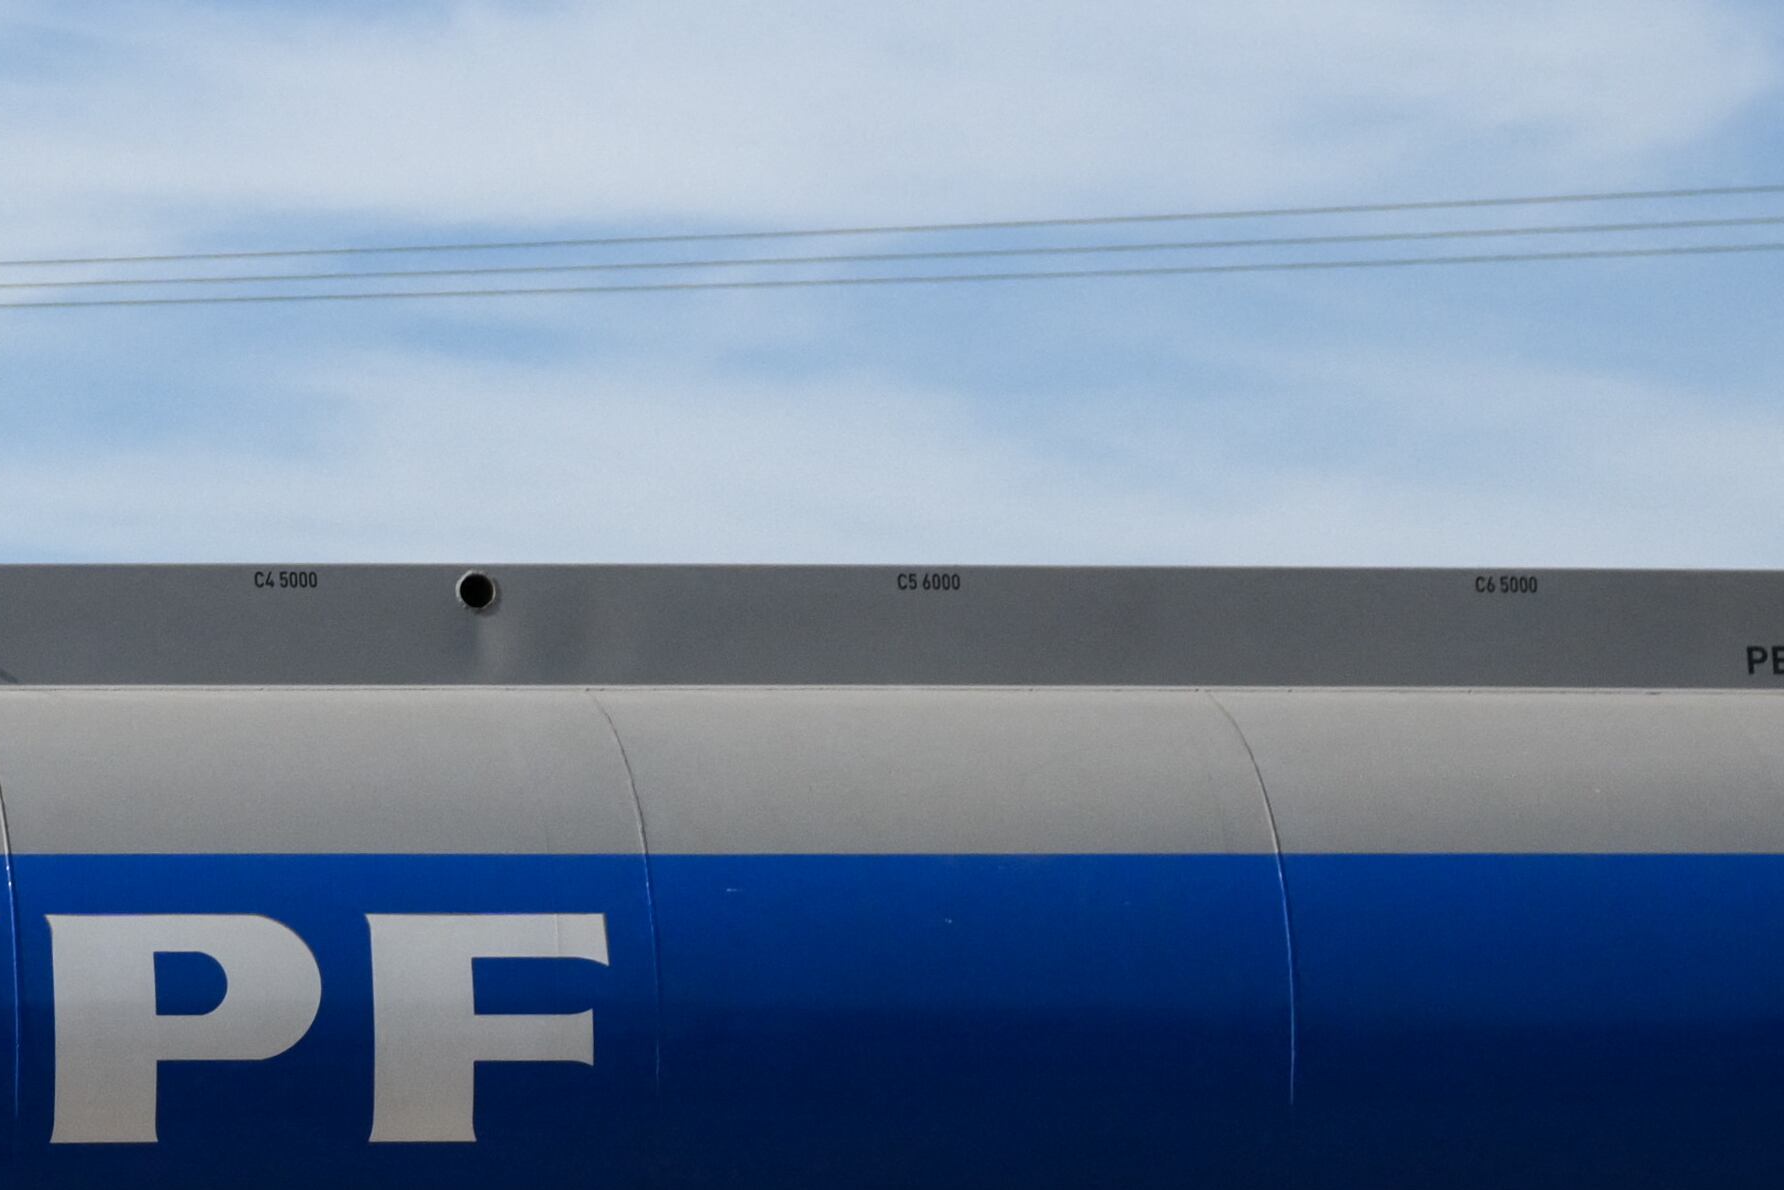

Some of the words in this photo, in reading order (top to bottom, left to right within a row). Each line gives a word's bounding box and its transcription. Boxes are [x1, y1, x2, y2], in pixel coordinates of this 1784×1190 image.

[254, 571, 275, 589] C4
[279, 571, 318, 589] 5000
[897, 573, 918, 591] C5
[922, 573, 961, 591] 6000
[1475, 575, 1496, 594] C6
[1499, 575, 1538, 594] 5000
[1746, 645, 1784, 675] PE
